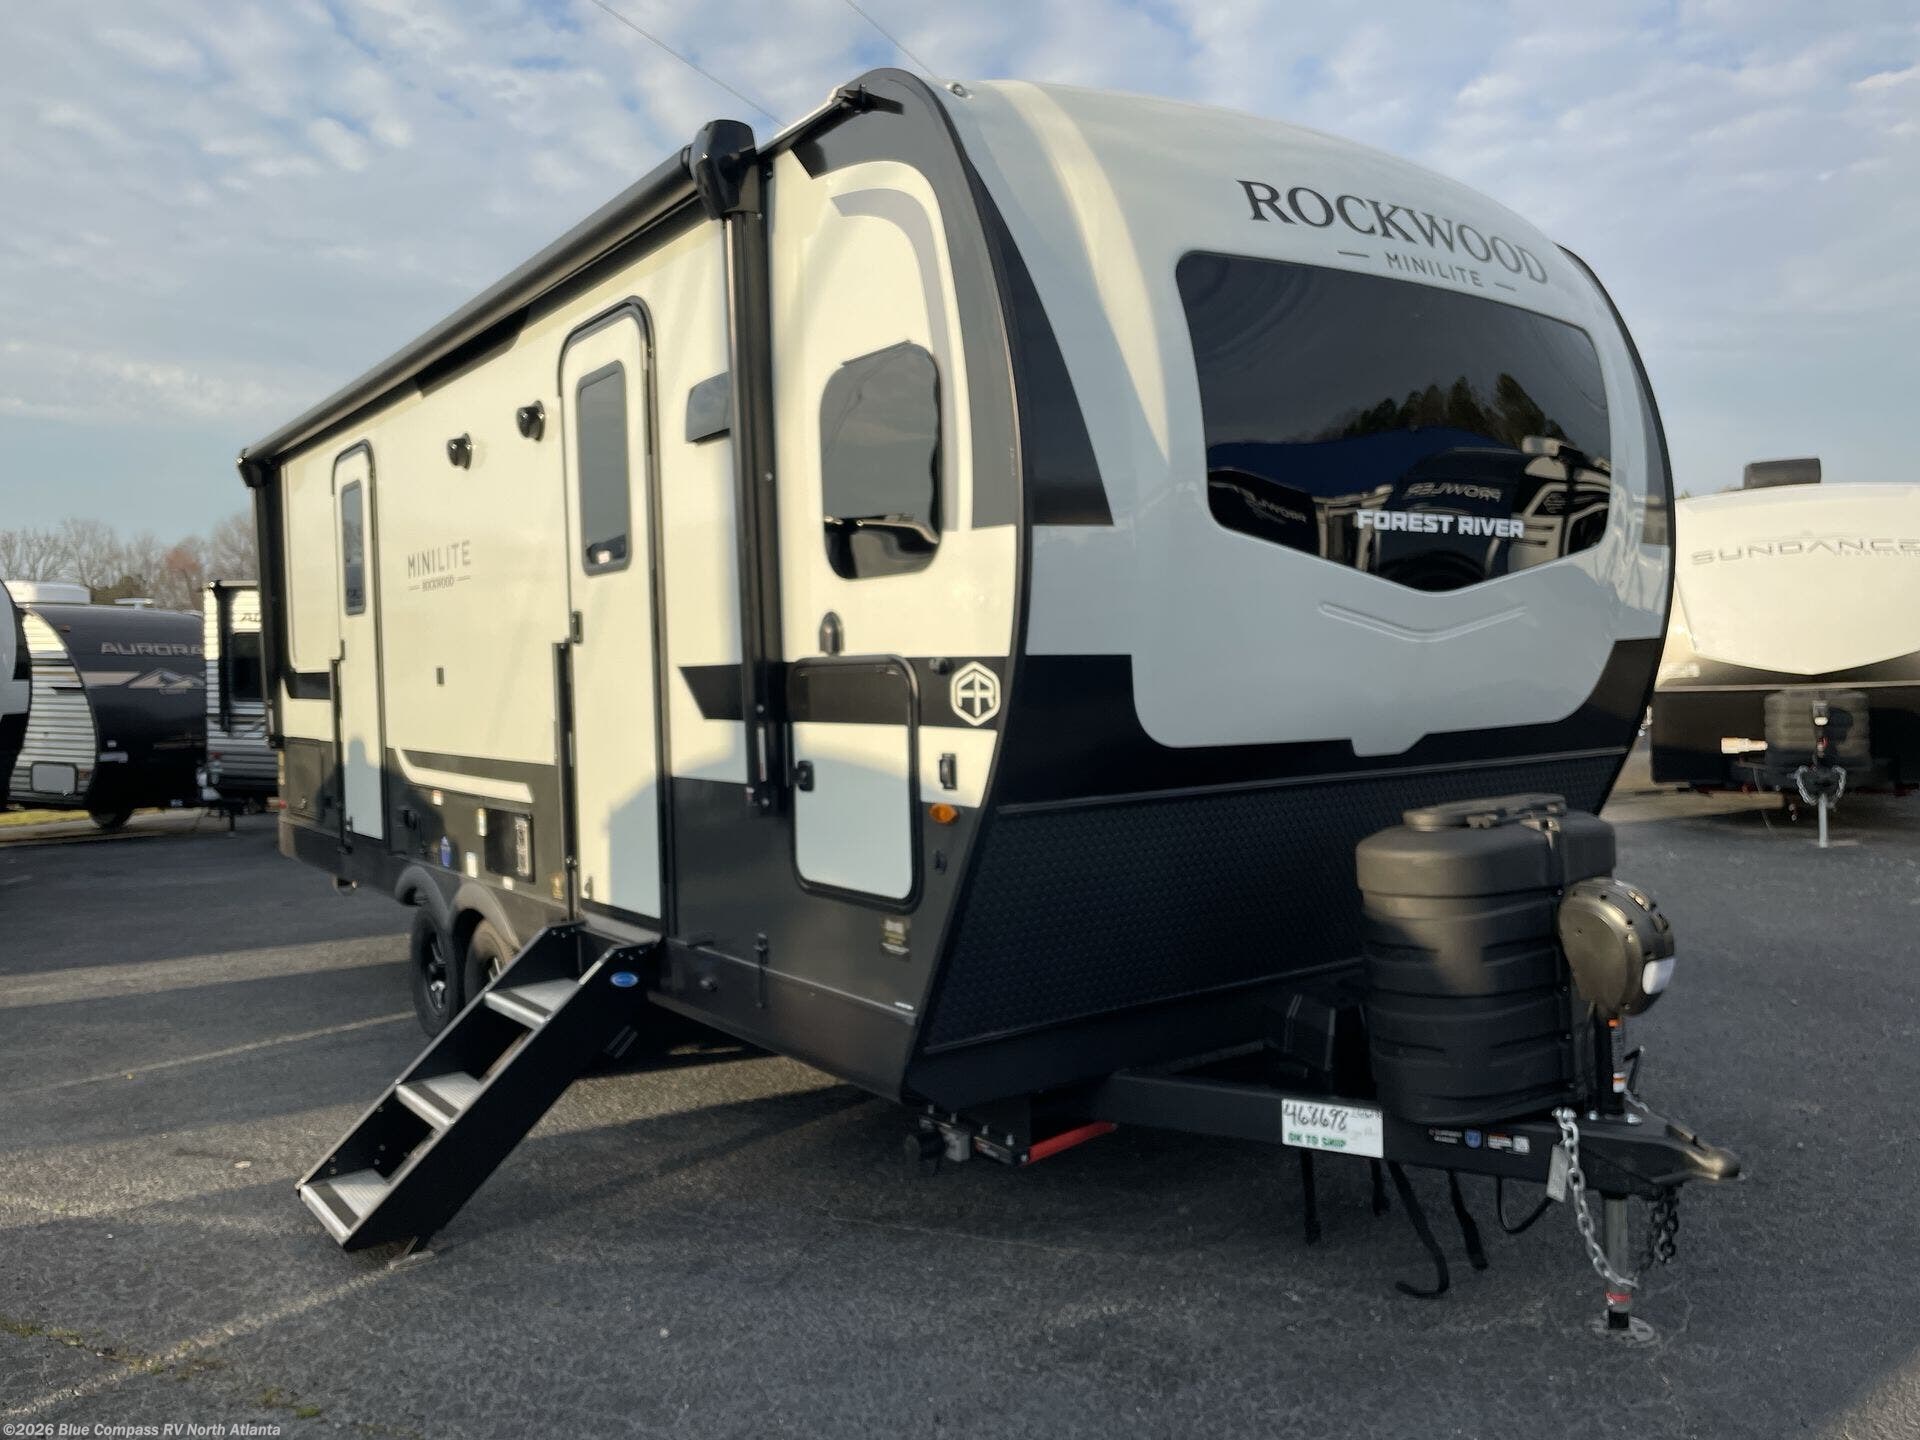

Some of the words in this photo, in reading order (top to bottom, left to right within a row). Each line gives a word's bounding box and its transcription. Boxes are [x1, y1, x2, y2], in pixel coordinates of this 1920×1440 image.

[1236, 179, 1548, 285] ROCKWOOD
[1387, 252, 1483, 287] MINILITE
[1357, 509, 1454, 534] FOREST
[1458, 515, 1525, 539] RIVER
[407, 540, 471, 579] MINILITE
[1692, 538, 1920, 566] SUNDANCE
